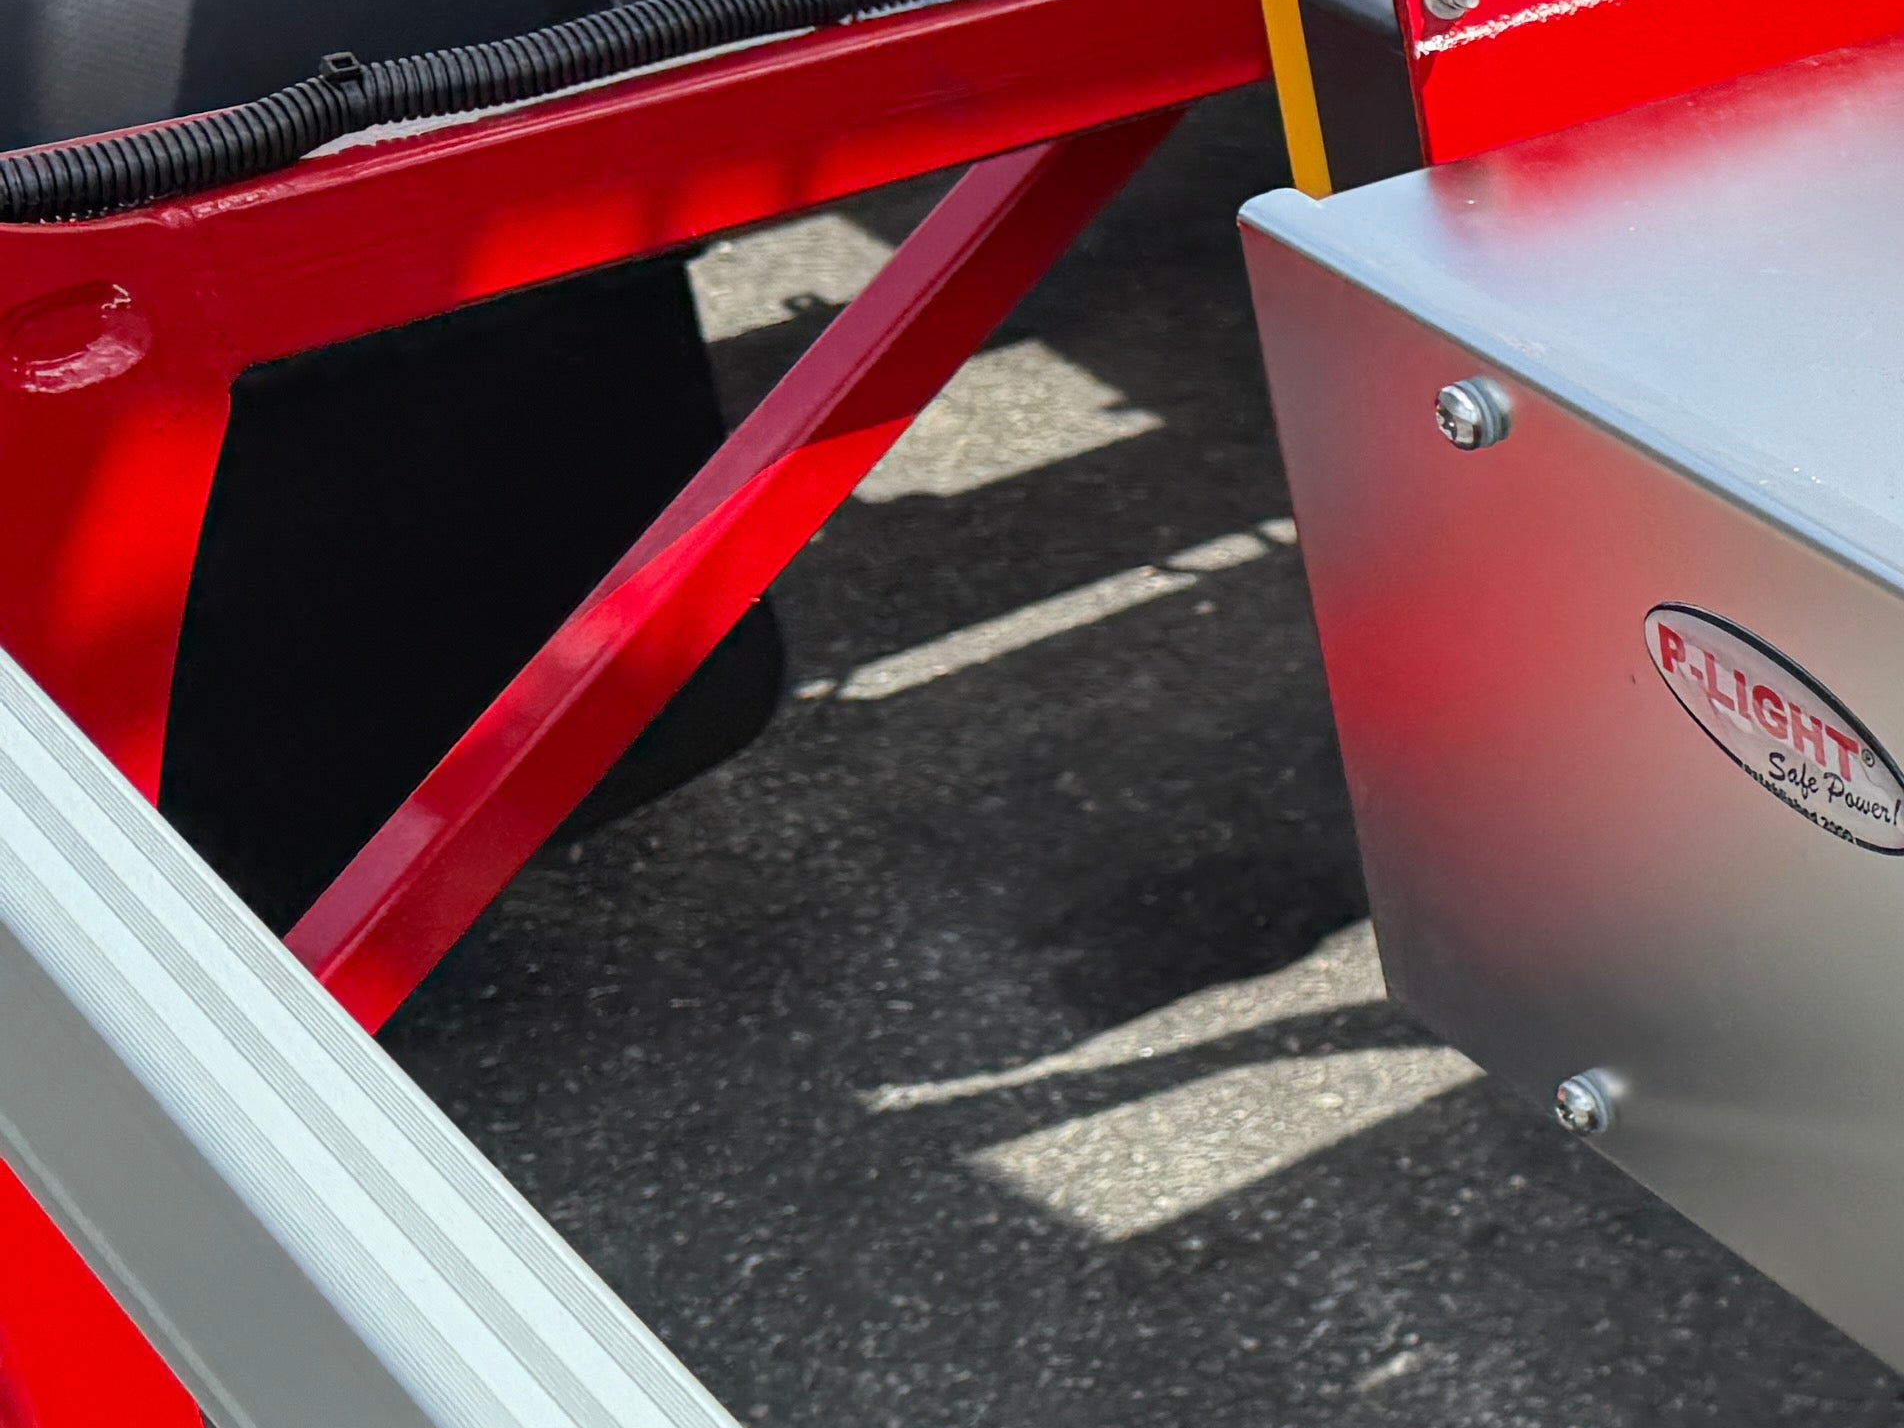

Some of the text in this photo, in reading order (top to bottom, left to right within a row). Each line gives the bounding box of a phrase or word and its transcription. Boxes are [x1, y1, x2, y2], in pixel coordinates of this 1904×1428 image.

[1658, 622, 1860, 783] P-LIGHT
[1768, 752, 1902, 826] Safe Power!
